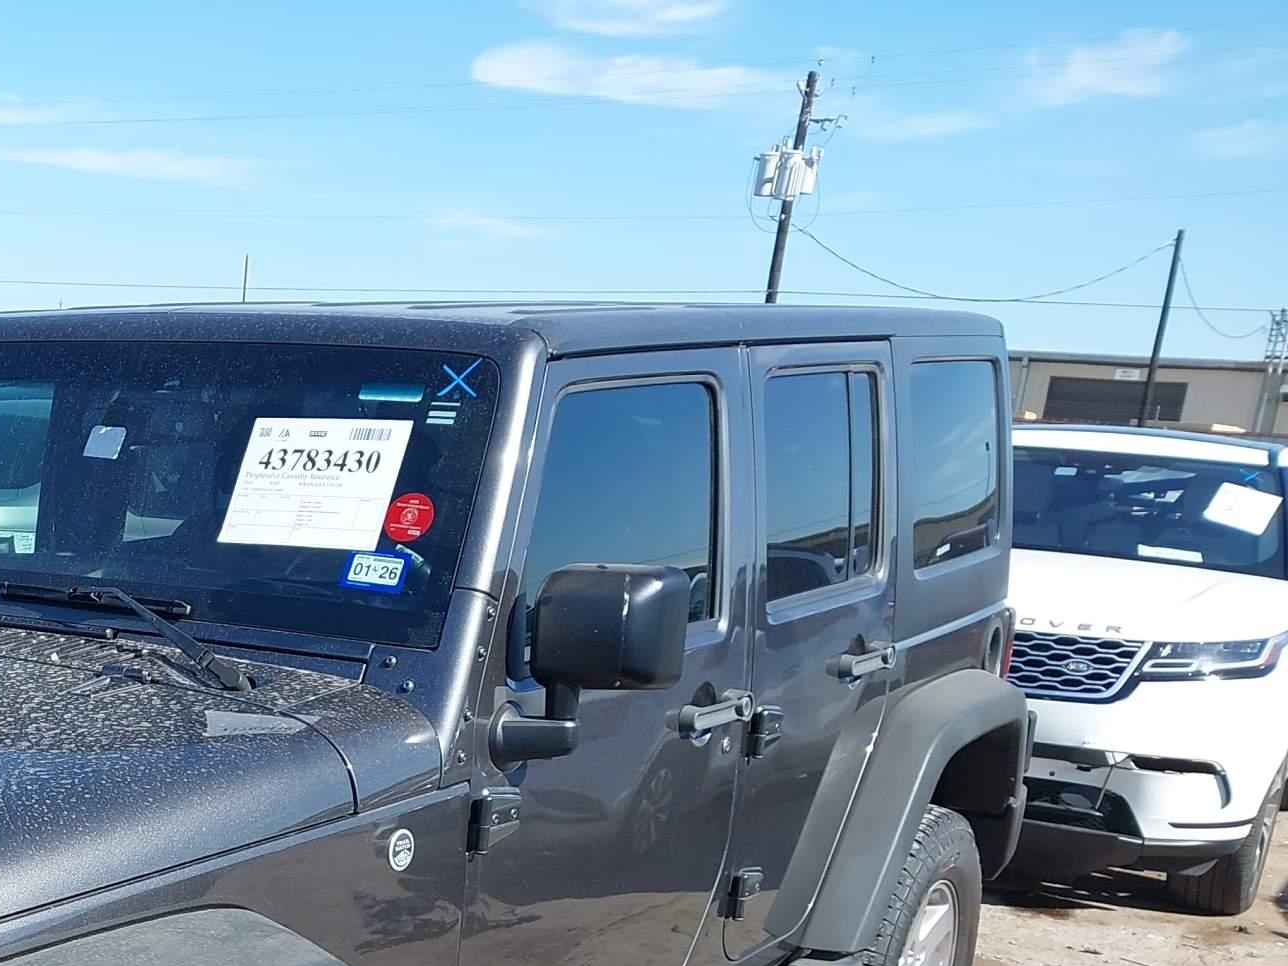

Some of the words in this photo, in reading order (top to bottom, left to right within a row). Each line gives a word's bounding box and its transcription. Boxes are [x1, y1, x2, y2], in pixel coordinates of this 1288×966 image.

[258, 448, 381, 473] 43783430
[353, 562, 372, 577] 01
[378, 565, 399, 581] 26
[1020, 618, 1122, 633] OVER
